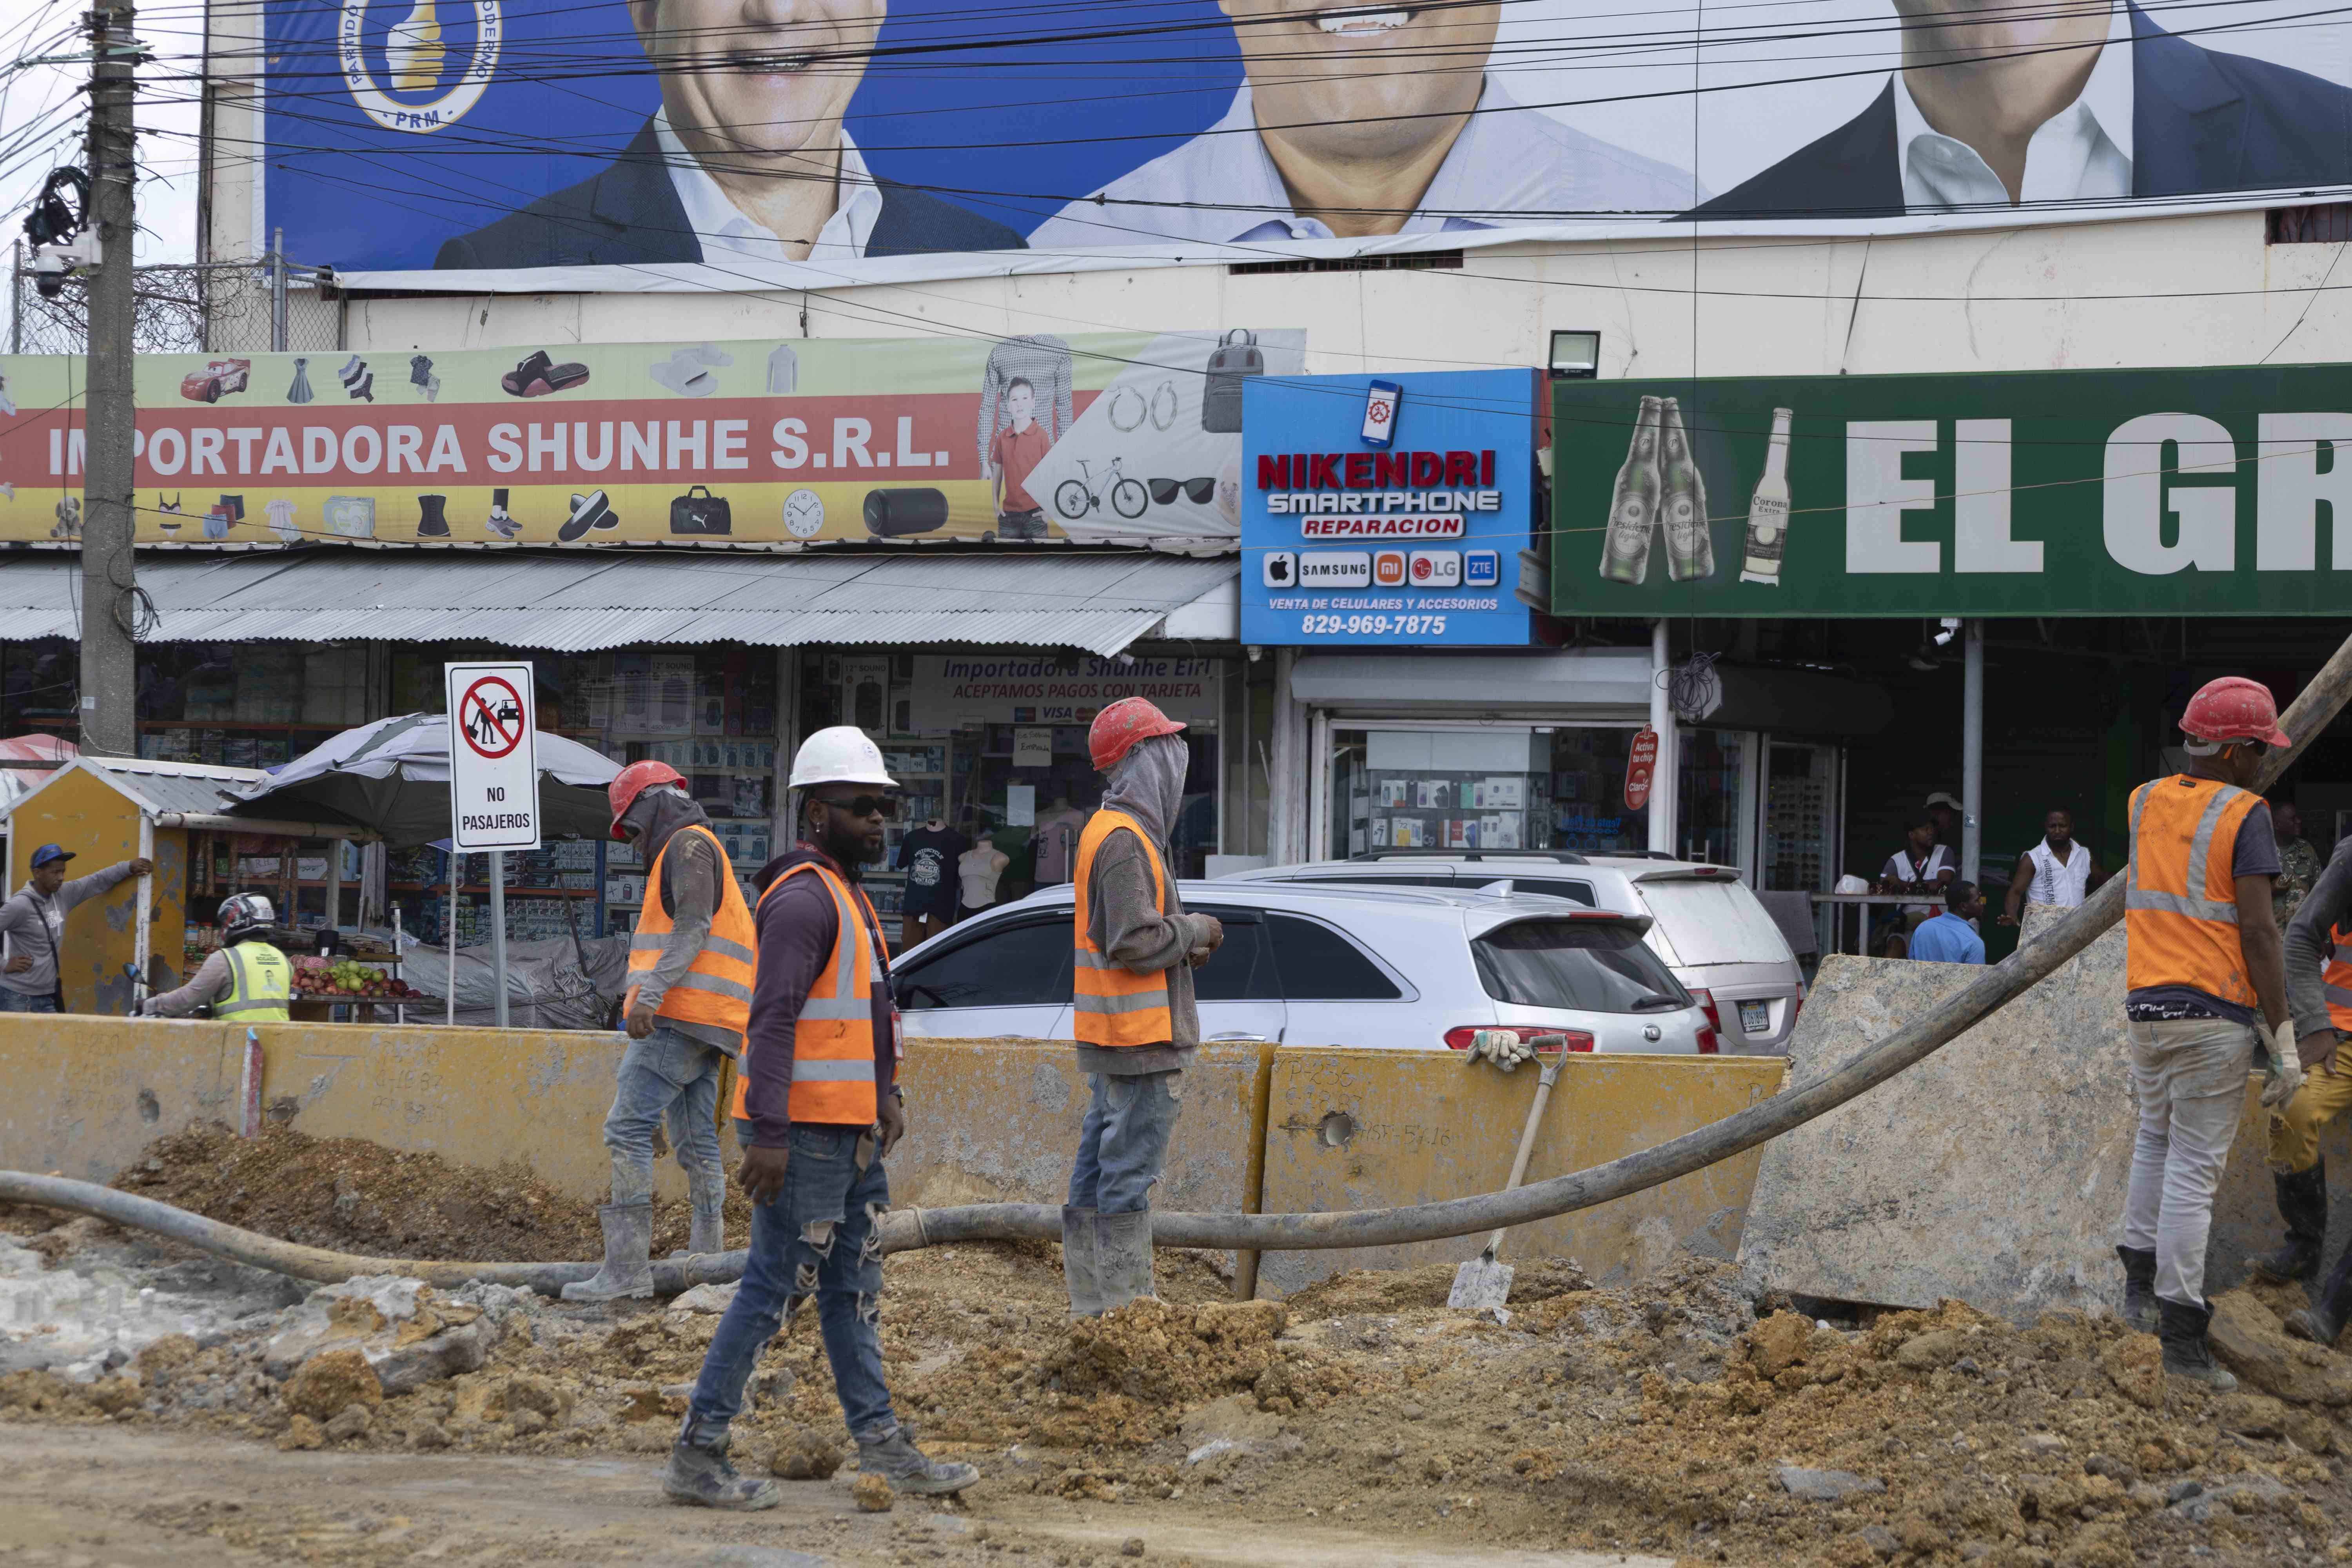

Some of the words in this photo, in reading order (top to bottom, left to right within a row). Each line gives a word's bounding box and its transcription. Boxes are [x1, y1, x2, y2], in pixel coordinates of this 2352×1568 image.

[345, 4, 362, 85] PARTIDO
[395, 110, 439, 129] PRM
[486, 419, 749, 473] SHUNHE
[771, 416, 949, 470] S.R.L.
[1257, 450, 1496, 490] NIKENDRI
[1267, 491, 1501, 514] SMARTPHONE
[1753, 496, 1788, 508] Corona
[1846, 418, 2044, 574] EL
[1304, 519, 1460, 535] REPARACION
[1302, 564, 1367, 576] SAMSUNG
[1434, 561, 1456, 576] LG
[1470, 563, 1492, 574] ZTE
[1269, 599, 1308, 610] VENTA
[1312, 599, 1328, 610] DE
[1331, 598, 1402, 610] CELULARES
[1406, 598, 1415, 610] Y
[1417, 598, 1498, 610] ACCESORIOS
[1301, 614, 1446, 635] 829-969-7875
[1086, 658, 1167, 677] Shunhe
[953, 684, 1044, 699] ACEPTAMOS
[1047, 684, 1098, 698] PAGOS
[1102, 683, 1135, 697] CON
[1140, 683, 1201, 698] TARJETA
[1042, 707, 1073, 718] VISA
[1635, 742, 1653, 752] Activa
[1633, 754, 1640, 763] tu
[1640, 753, 1653, 763] chip
[486, 787, 505, 802] NO
[1629, 782, 1646, 792] Claro
[463, 813, 530, 831] PASAJEROS
[915, 848, 944, 860] MOTORCYCLE
[915, 864, 938, 873] RACER
